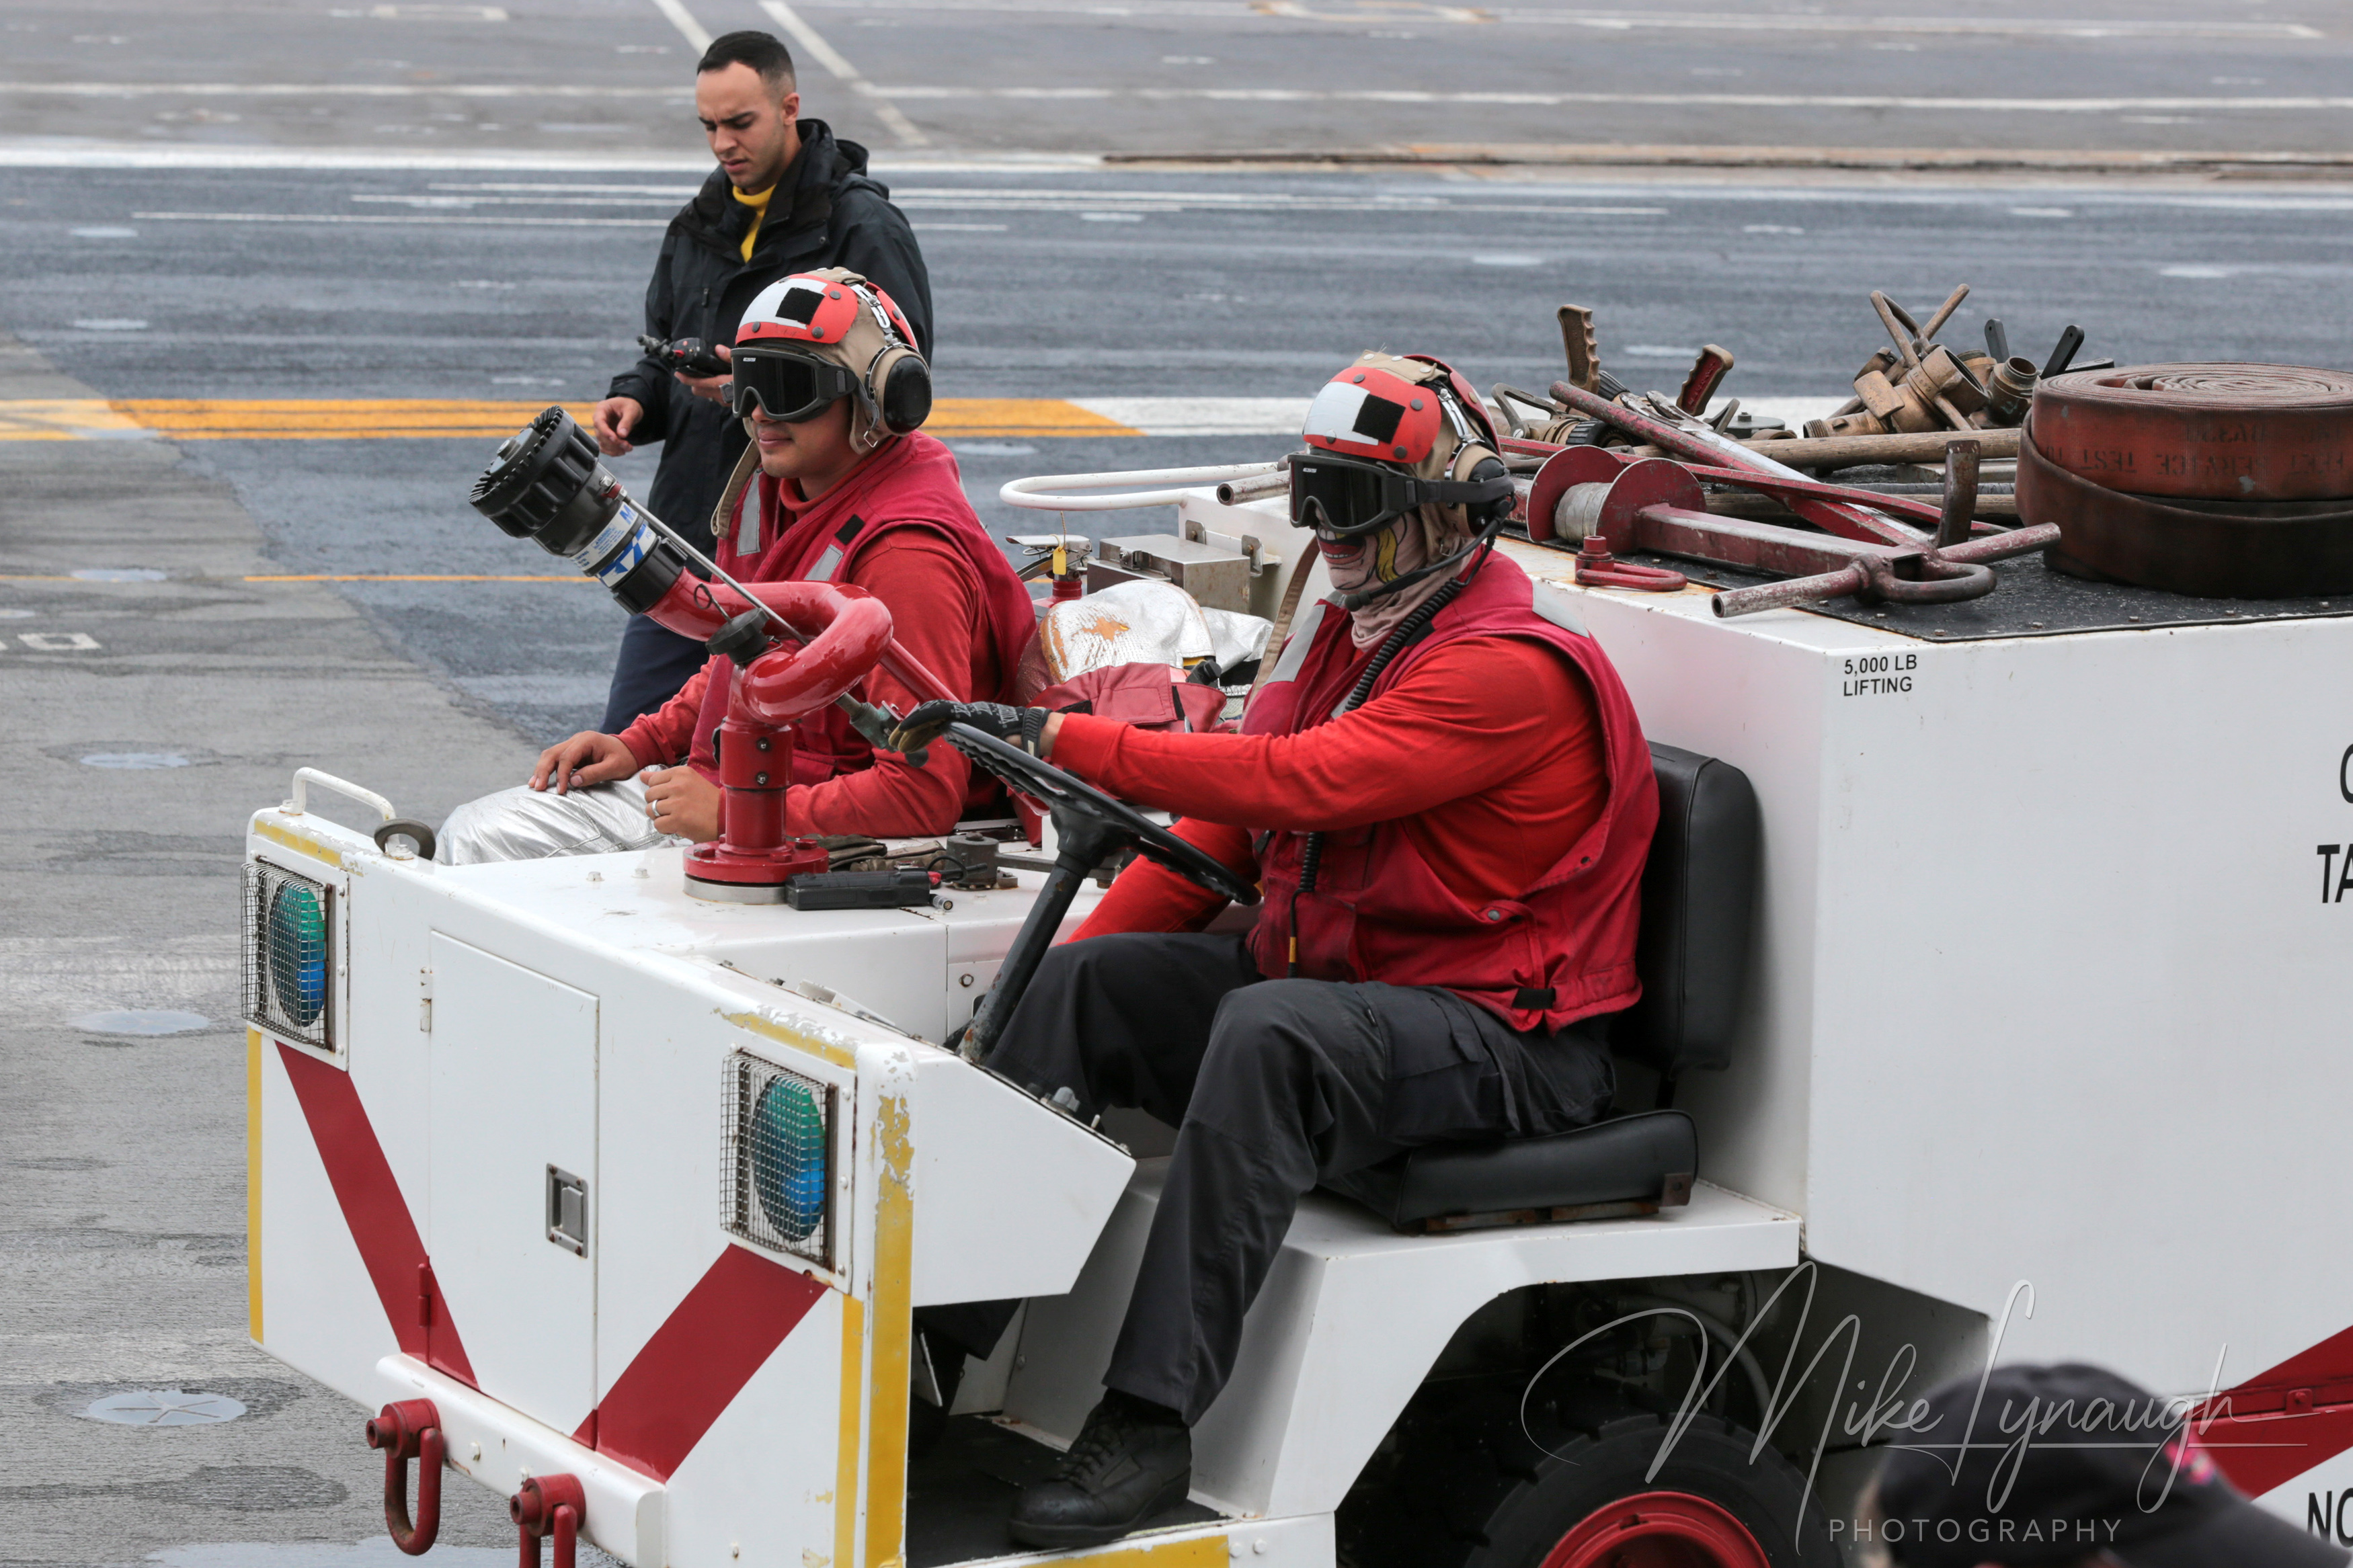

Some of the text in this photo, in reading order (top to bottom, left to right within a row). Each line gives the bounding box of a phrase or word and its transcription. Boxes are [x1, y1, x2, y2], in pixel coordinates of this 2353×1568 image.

[2080, 448, 2138, 474] TEST
[1844, 654, 1917, 677] 5,000 LB
[1843, 676, 1912, 696] LIFTING
